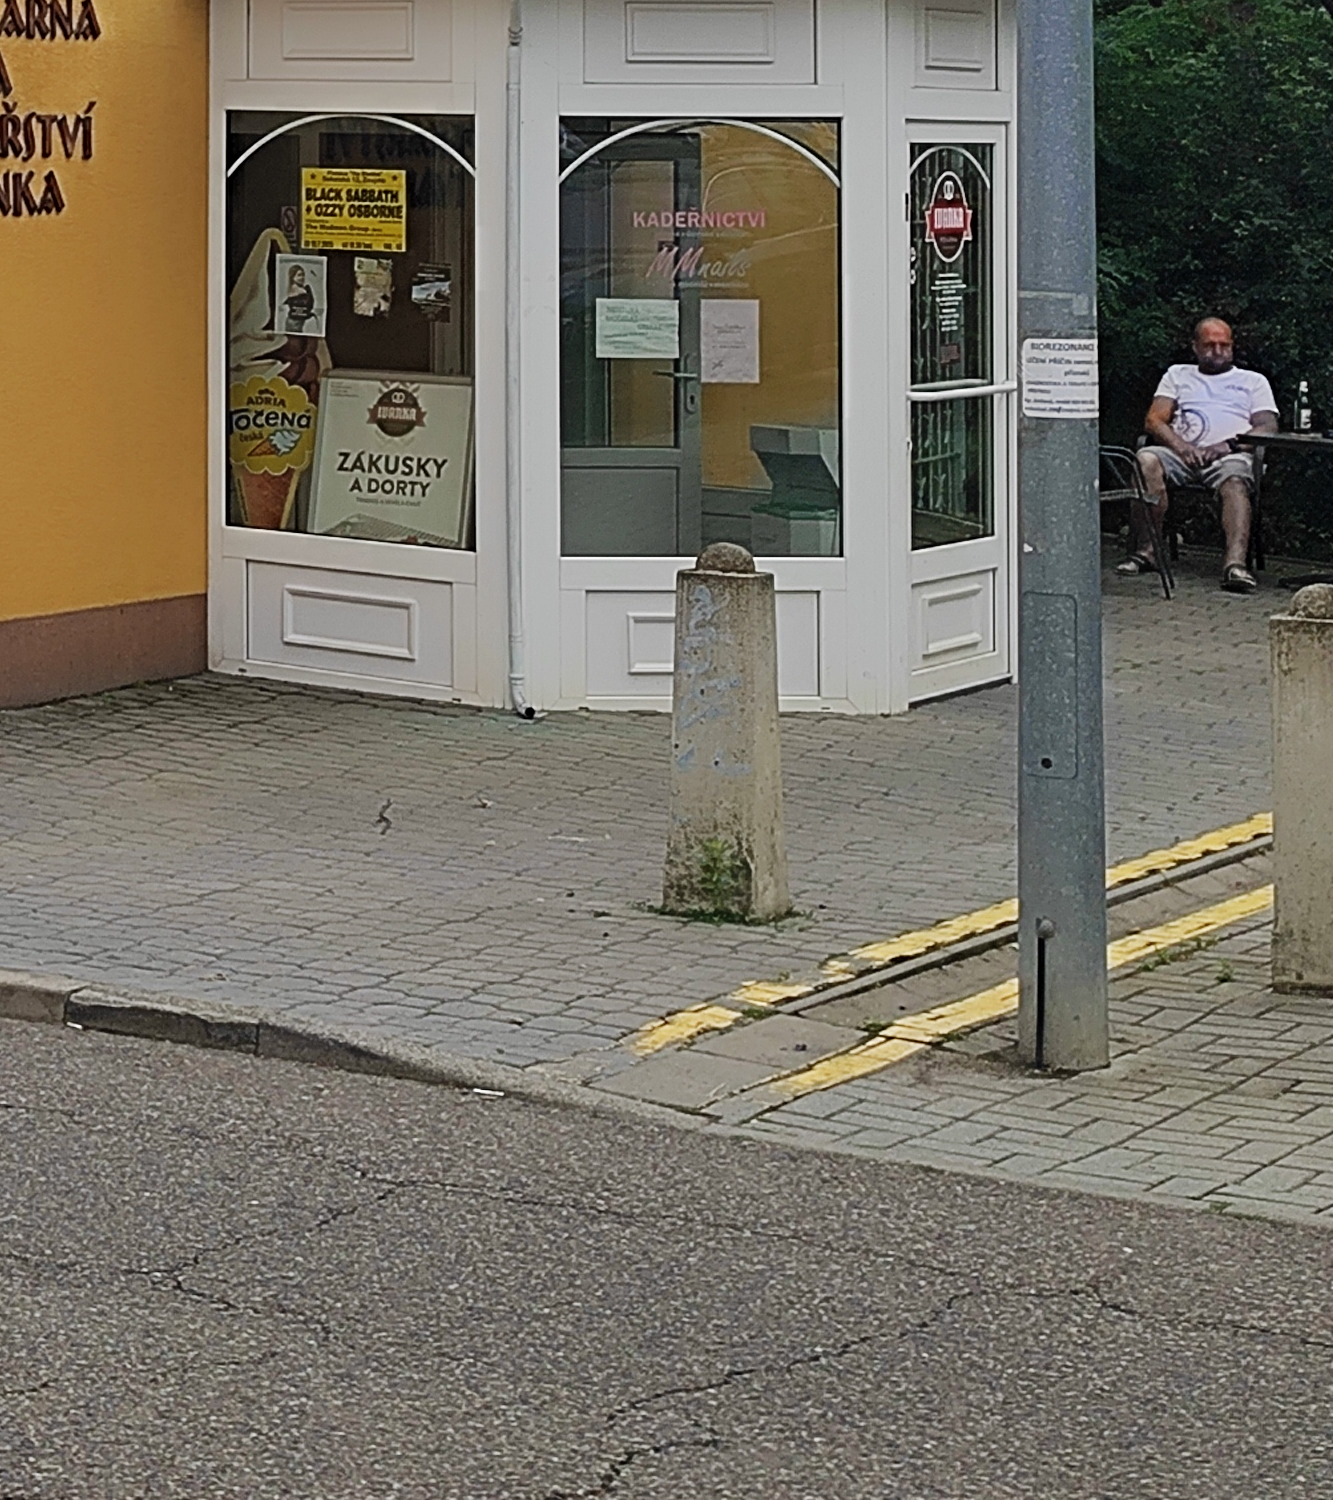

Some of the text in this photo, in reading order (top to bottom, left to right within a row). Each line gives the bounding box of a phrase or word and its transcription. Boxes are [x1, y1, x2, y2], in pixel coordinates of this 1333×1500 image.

[305, 186, 399, 204] BLACK SABBATH
[314, 203, 346, 218] OZZY
[347, 204, 404, 220] OSBORNE
[633, 206, 767, 228] KADEŘNICTVÍ
[246, 395, 287, 408] ADRIA
[336, 450, 449, 479] ZÁKUSKY
[348, 477, 432, 498] A DORTY
